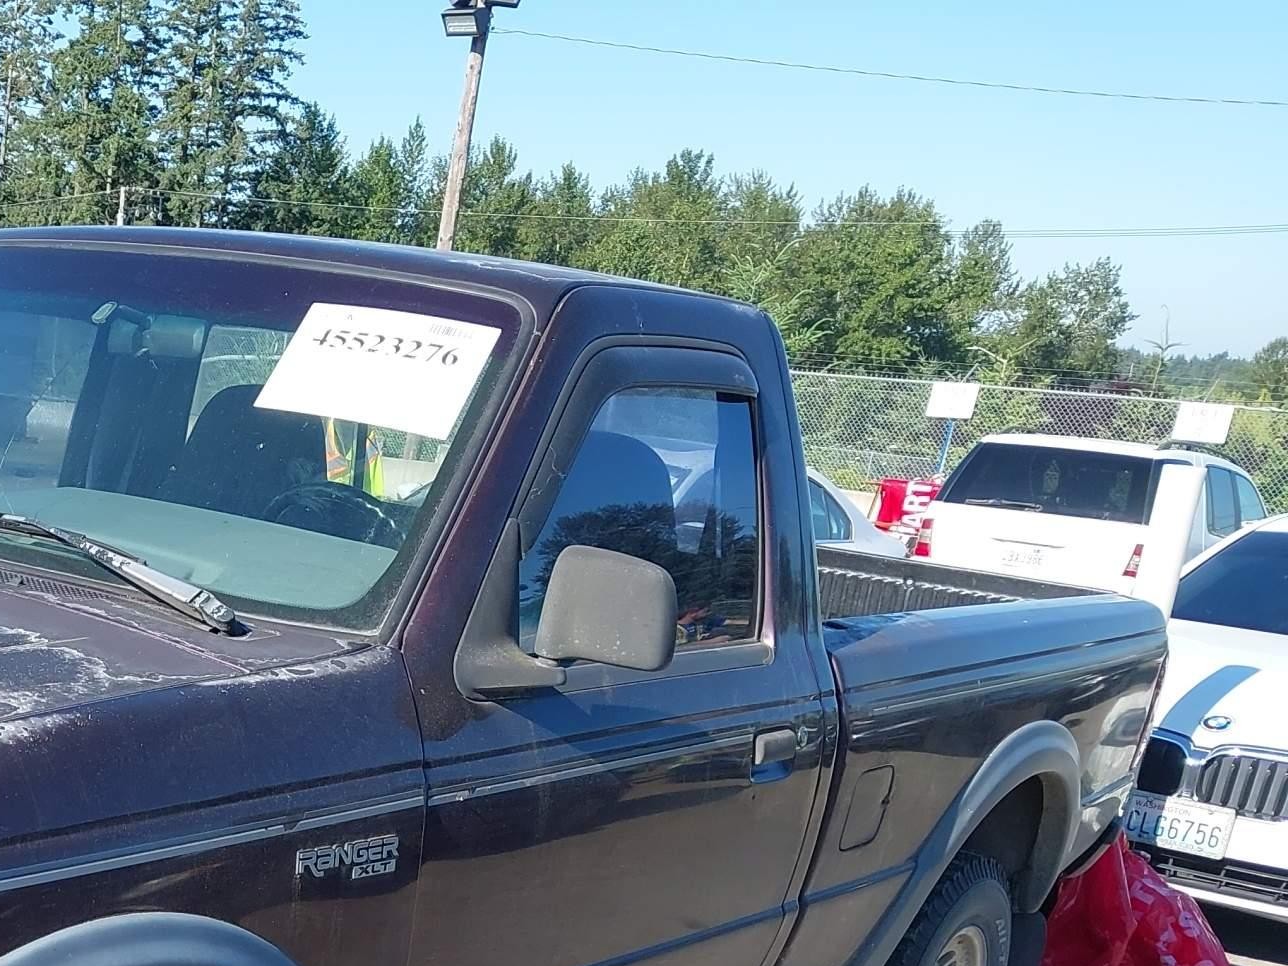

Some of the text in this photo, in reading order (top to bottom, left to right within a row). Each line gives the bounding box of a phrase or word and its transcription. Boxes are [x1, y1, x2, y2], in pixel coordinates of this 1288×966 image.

[312, 329, 459, 366] 45523276
[1127, 809, 1223, 849] CLG6756
[357, 861, 393, 877] XLT
